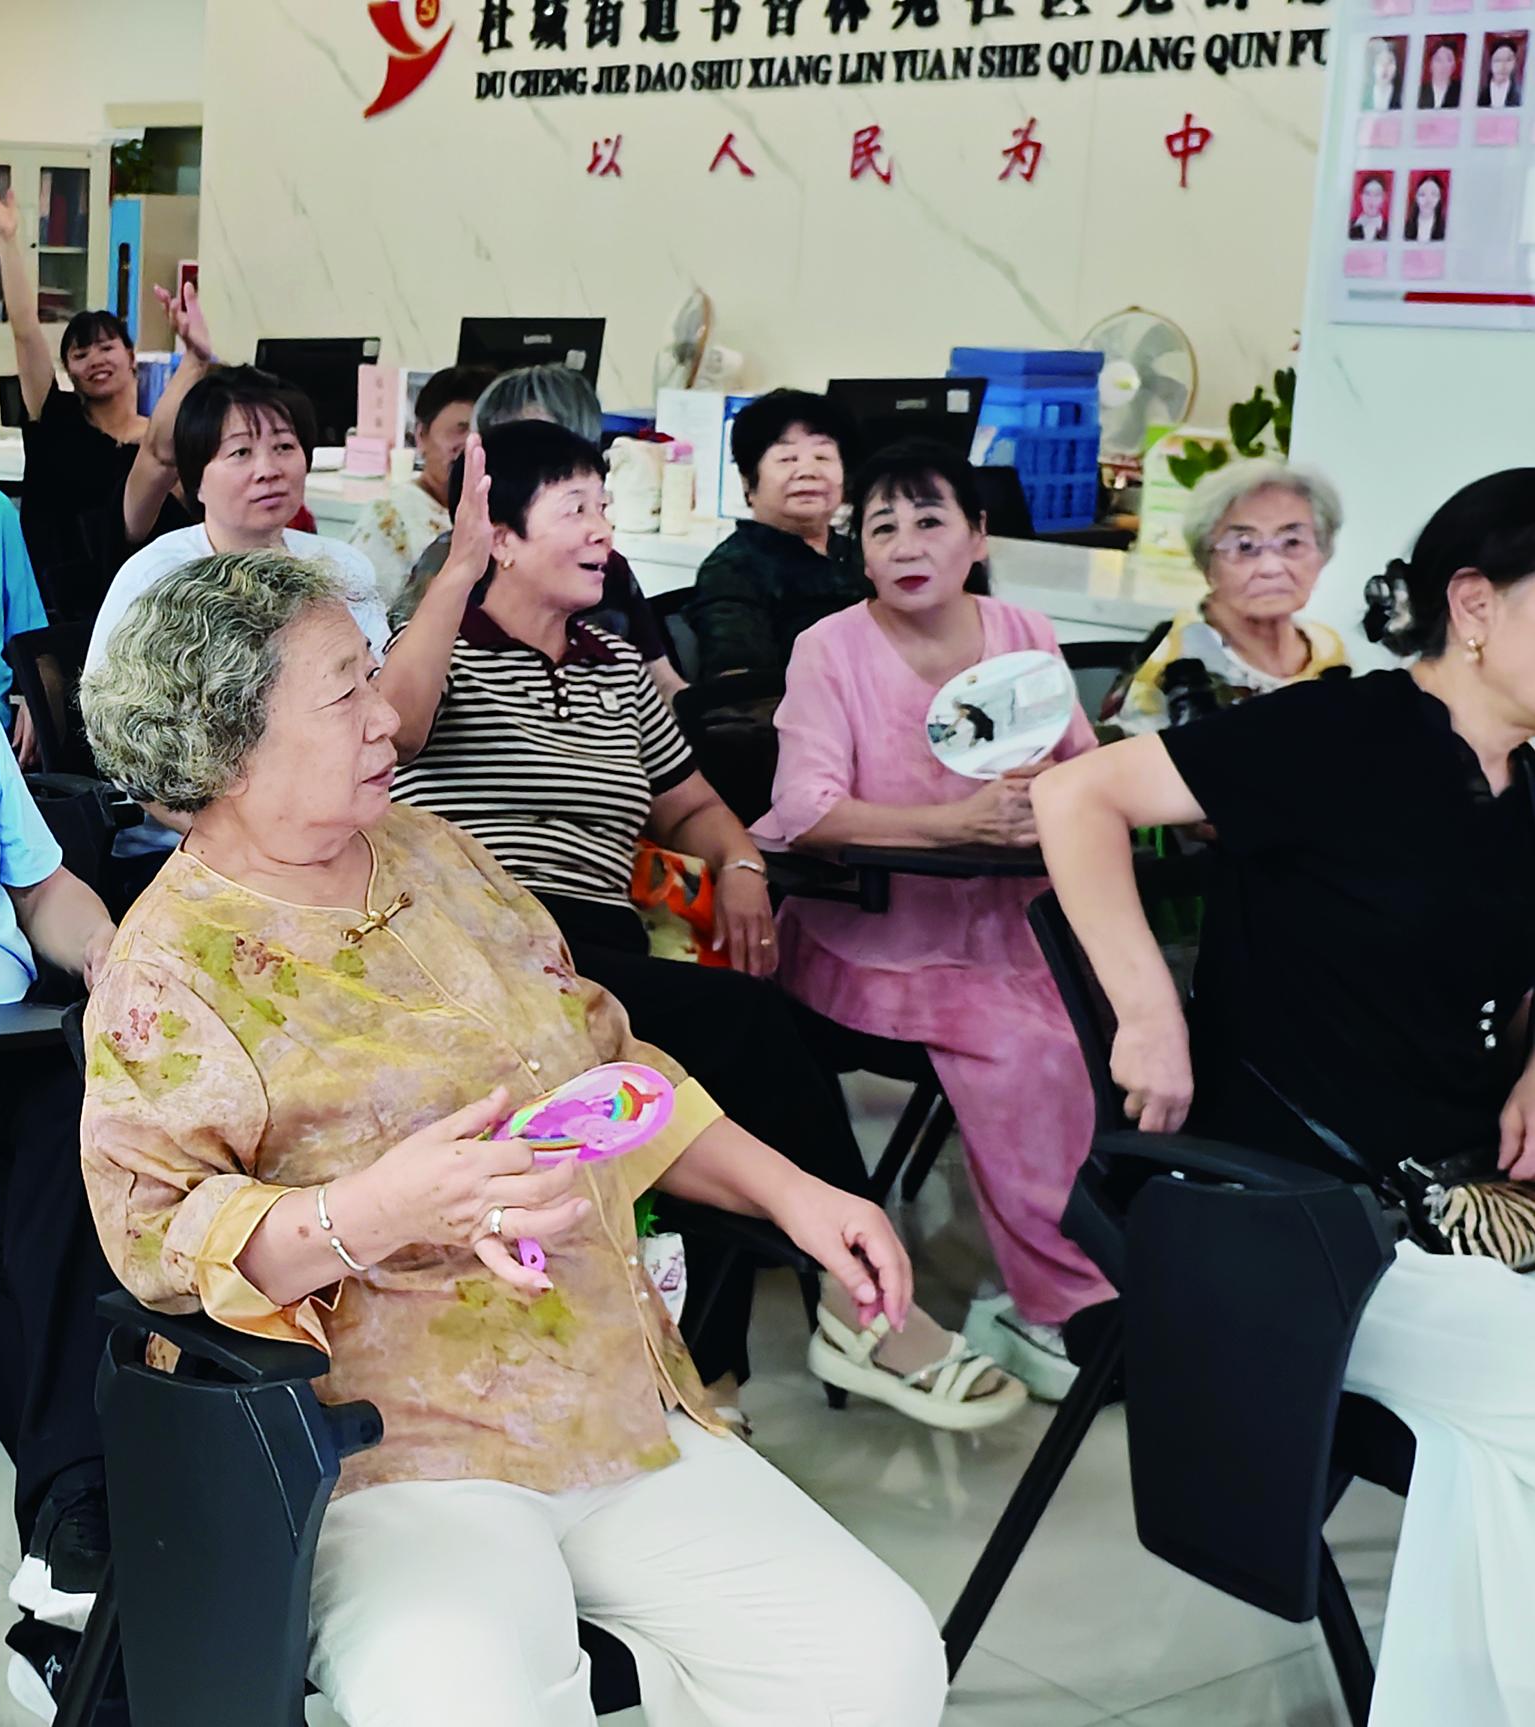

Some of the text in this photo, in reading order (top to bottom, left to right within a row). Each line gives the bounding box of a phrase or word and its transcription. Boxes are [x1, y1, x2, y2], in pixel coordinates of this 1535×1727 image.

[476, 71, 506, 99] DU
[510, 67, 587, 97] CHENG
[592, 64, 630, 94] JIE
[635, 62, 686, 92] DAO
[691, 58, 743, 90] SHU
[747, 55, 832, 88] XIANG
[838, 51, 886, 84] LIN
[892, 46, 974, 82] YUAN
[978, 43, 1041, 78] SHE
[1048, 40, 1094, 81] QU
[1100, 35, 1195, 74] DANG
[1204, 30, 1281, 76] QUN
